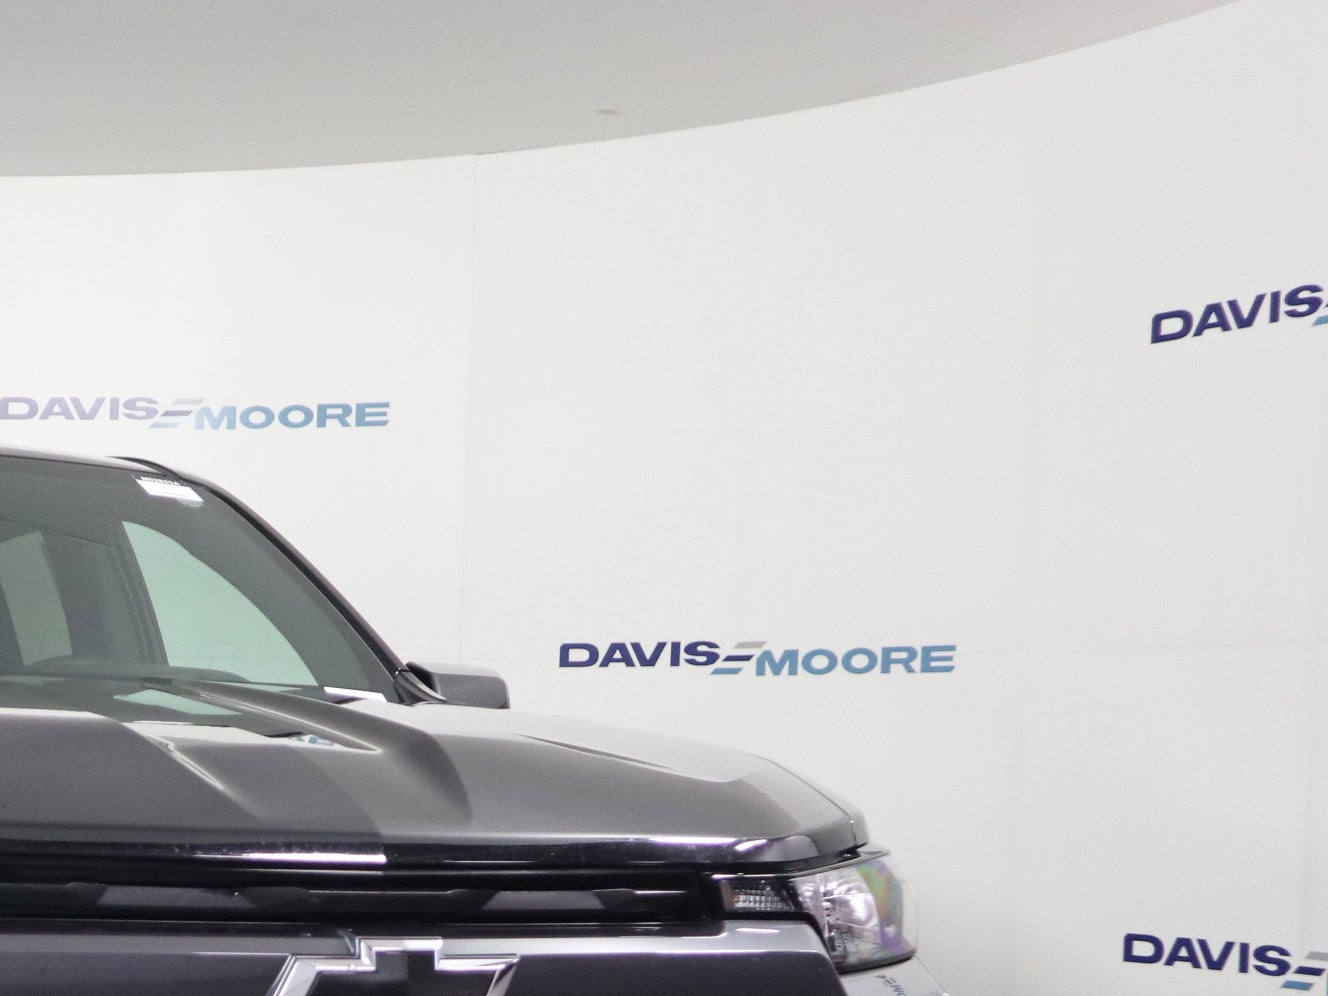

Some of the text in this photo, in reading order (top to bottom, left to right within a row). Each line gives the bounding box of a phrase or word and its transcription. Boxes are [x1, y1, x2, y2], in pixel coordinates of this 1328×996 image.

[1151, 284, 1324, 344] DAVIS
[194, 401, 390, 430] MOORE
[558, 640, 957, 676] DAVIS MOORE
[1123, 933, 1292, 976] DAVIS
